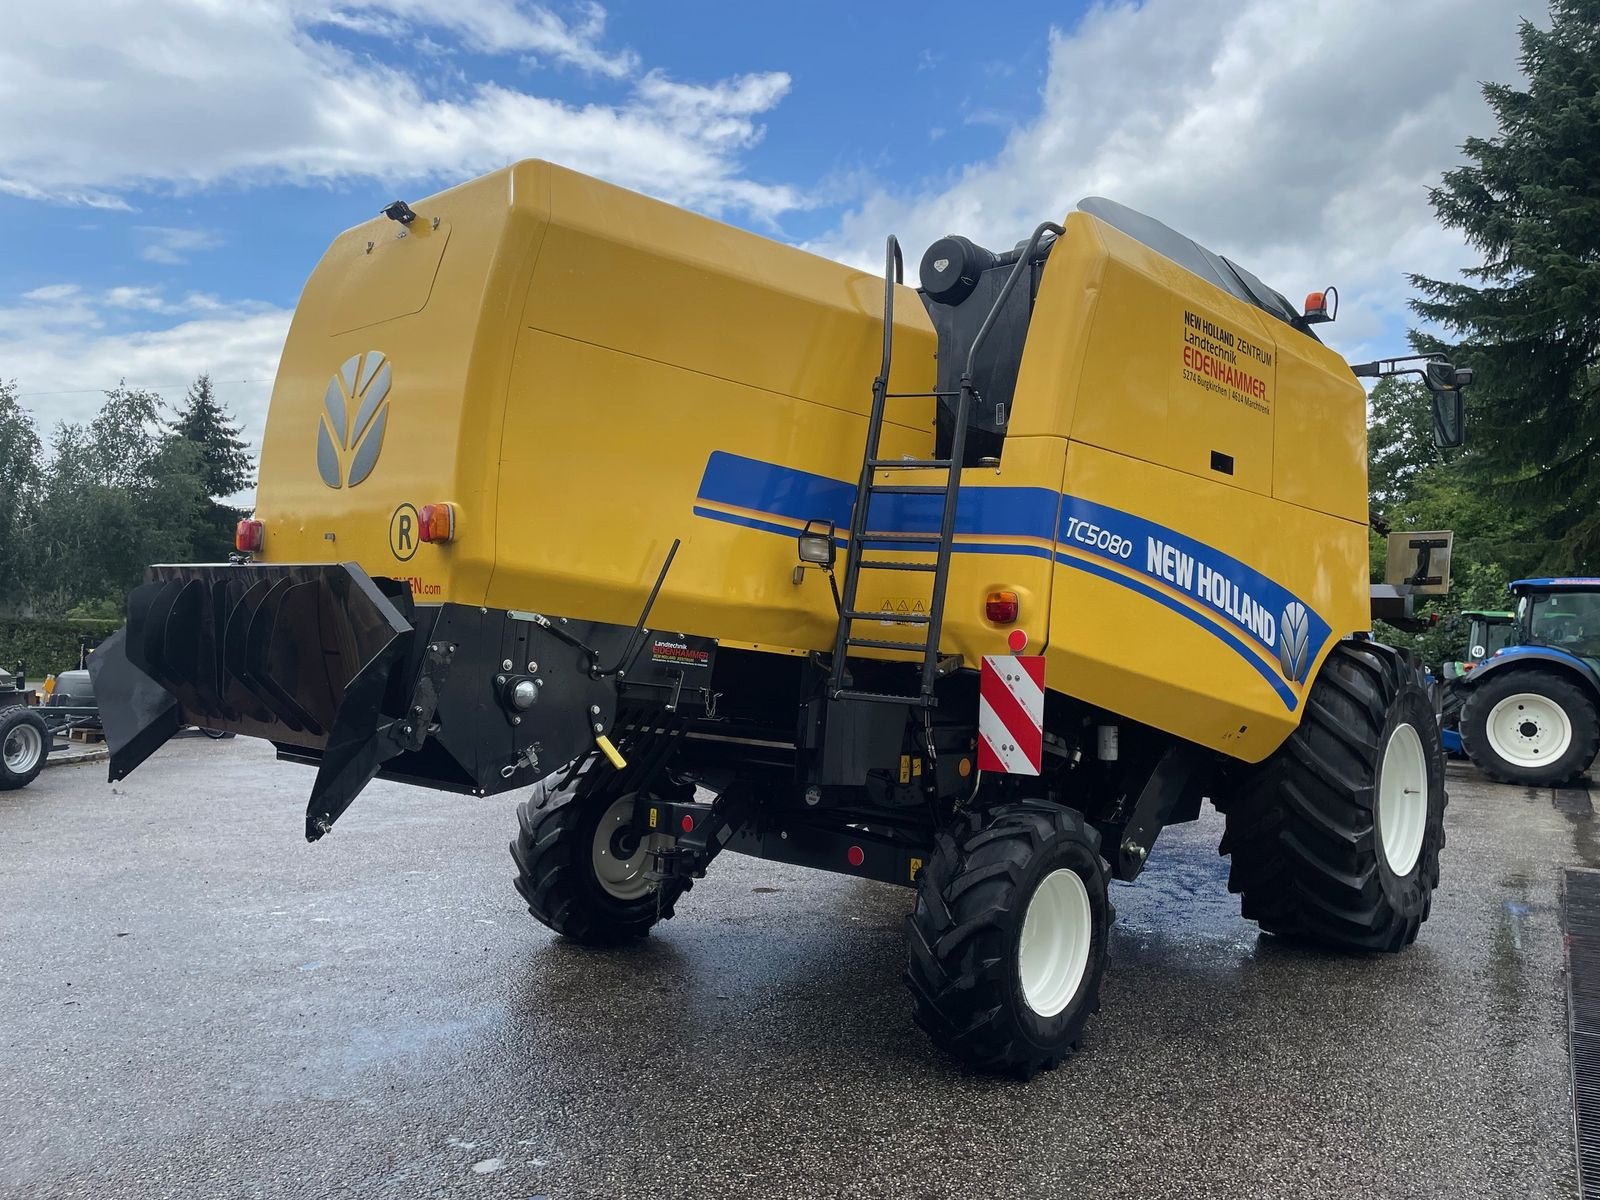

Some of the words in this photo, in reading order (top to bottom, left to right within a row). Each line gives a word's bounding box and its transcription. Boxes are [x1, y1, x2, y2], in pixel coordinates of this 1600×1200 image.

[1184, 327, 1237, 365] Landtechnik
[1185, 310, 1202, 331] NEW
[1203, 320, 1234, 347] HOLLAND
[1237, 338, 1272, 367] ZENTRUM
[1183, 346, 1266, 400] EIDENHAMMER
[1183, 369, 1197, 382] 5274
[1197, 375, 1227, 397] Burgkirchen
[399, 514, 412, 550] R
[1066, 516, 1133, 559] TC5080
[1147, 536, 1194, 590] NEW
[1197, 562, 1276, 647] HOLLAND
[652, 646, 709, 660] EIDENHAMMER
[654, 640, 688, 650] Landtechnik
